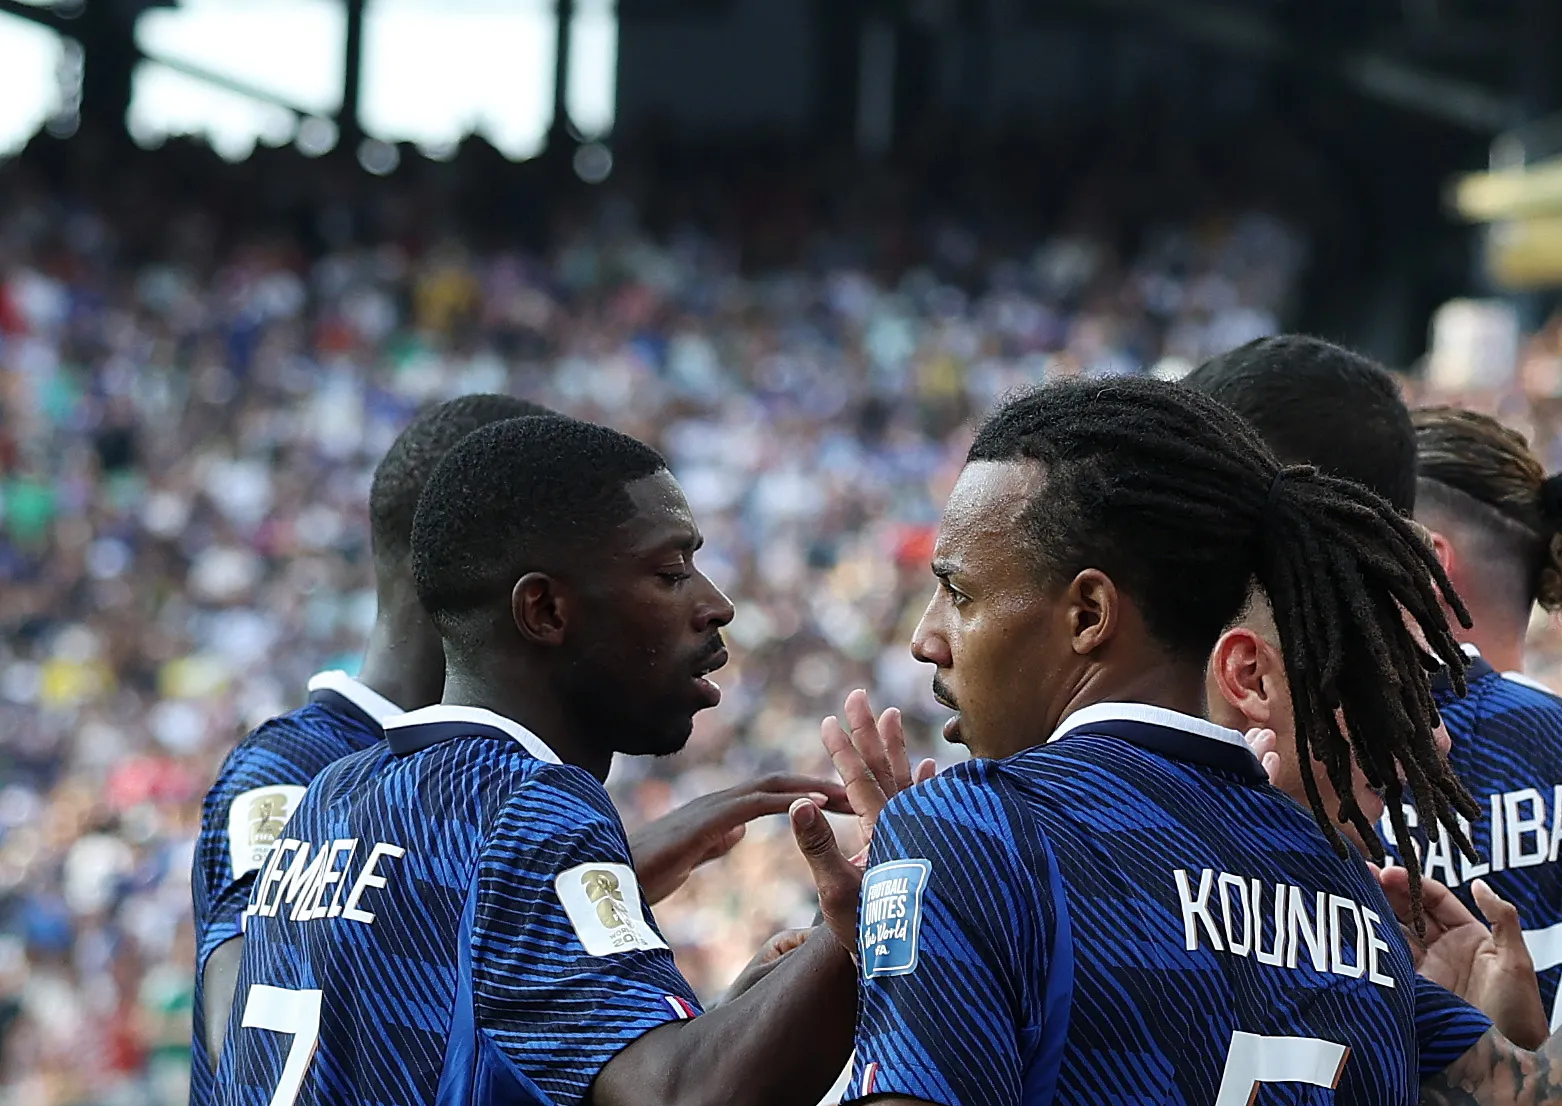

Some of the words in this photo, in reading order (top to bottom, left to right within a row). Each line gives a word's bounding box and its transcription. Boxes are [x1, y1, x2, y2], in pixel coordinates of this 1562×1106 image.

[867, 877, 908, 902] FOOTBALL
[865, 894, 907, 926] UNITES
[876, 918, 908, 942] World
[1173, 868, 1396, 988] KOUNDE
